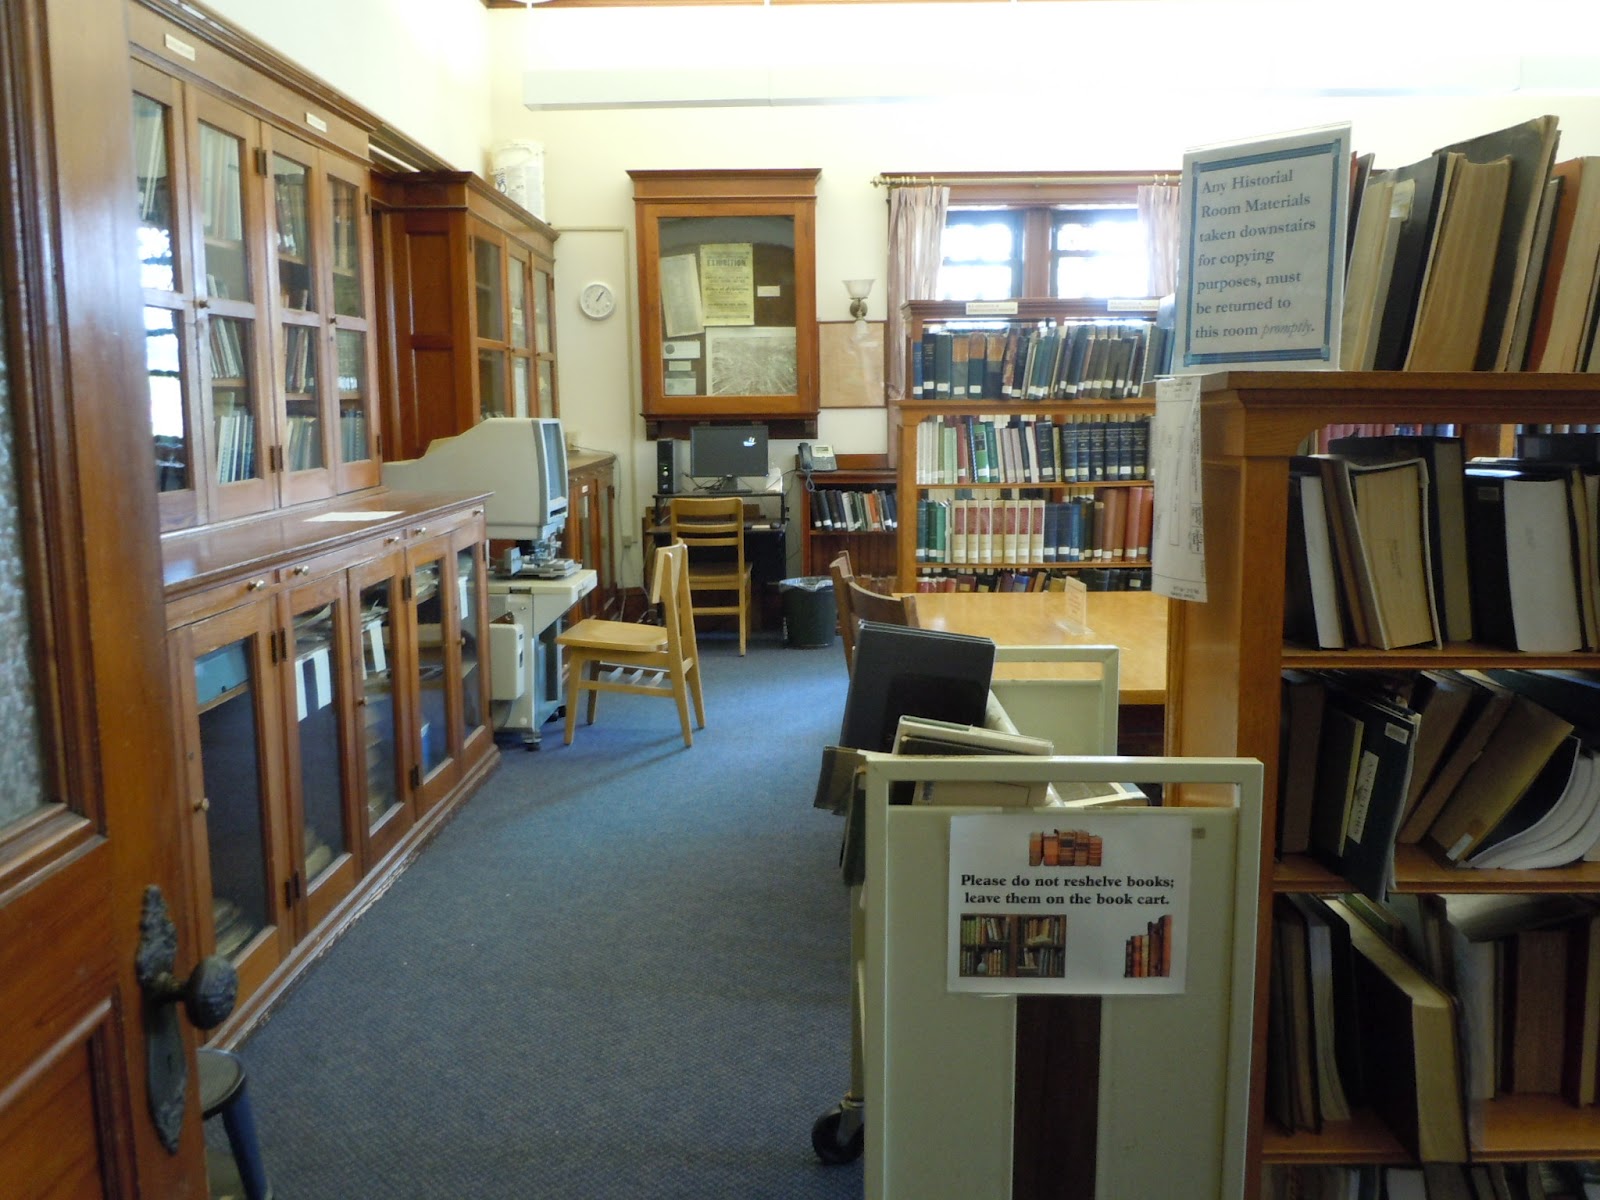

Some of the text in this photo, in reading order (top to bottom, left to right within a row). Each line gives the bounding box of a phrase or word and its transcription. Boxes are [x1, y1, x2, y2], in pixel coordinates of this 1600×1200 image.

[1201, 169, 1294, 196] Any Historial
[1201, 192, 1311, 218] Room Materials
[1199, 218, 1316, 242] taken downstairs
[1198, 249, 1276, 268] for copying
[1196, 272, 1302, 295] purposes, must
[1196, 297, 1291, 315] be returned to
[1195, 318, 1316, 340] this room promptly.
[961, 874, 1175, 889] Please do not reshelve books;
[964, 892, 1170, 905] leave them on the book cart.
